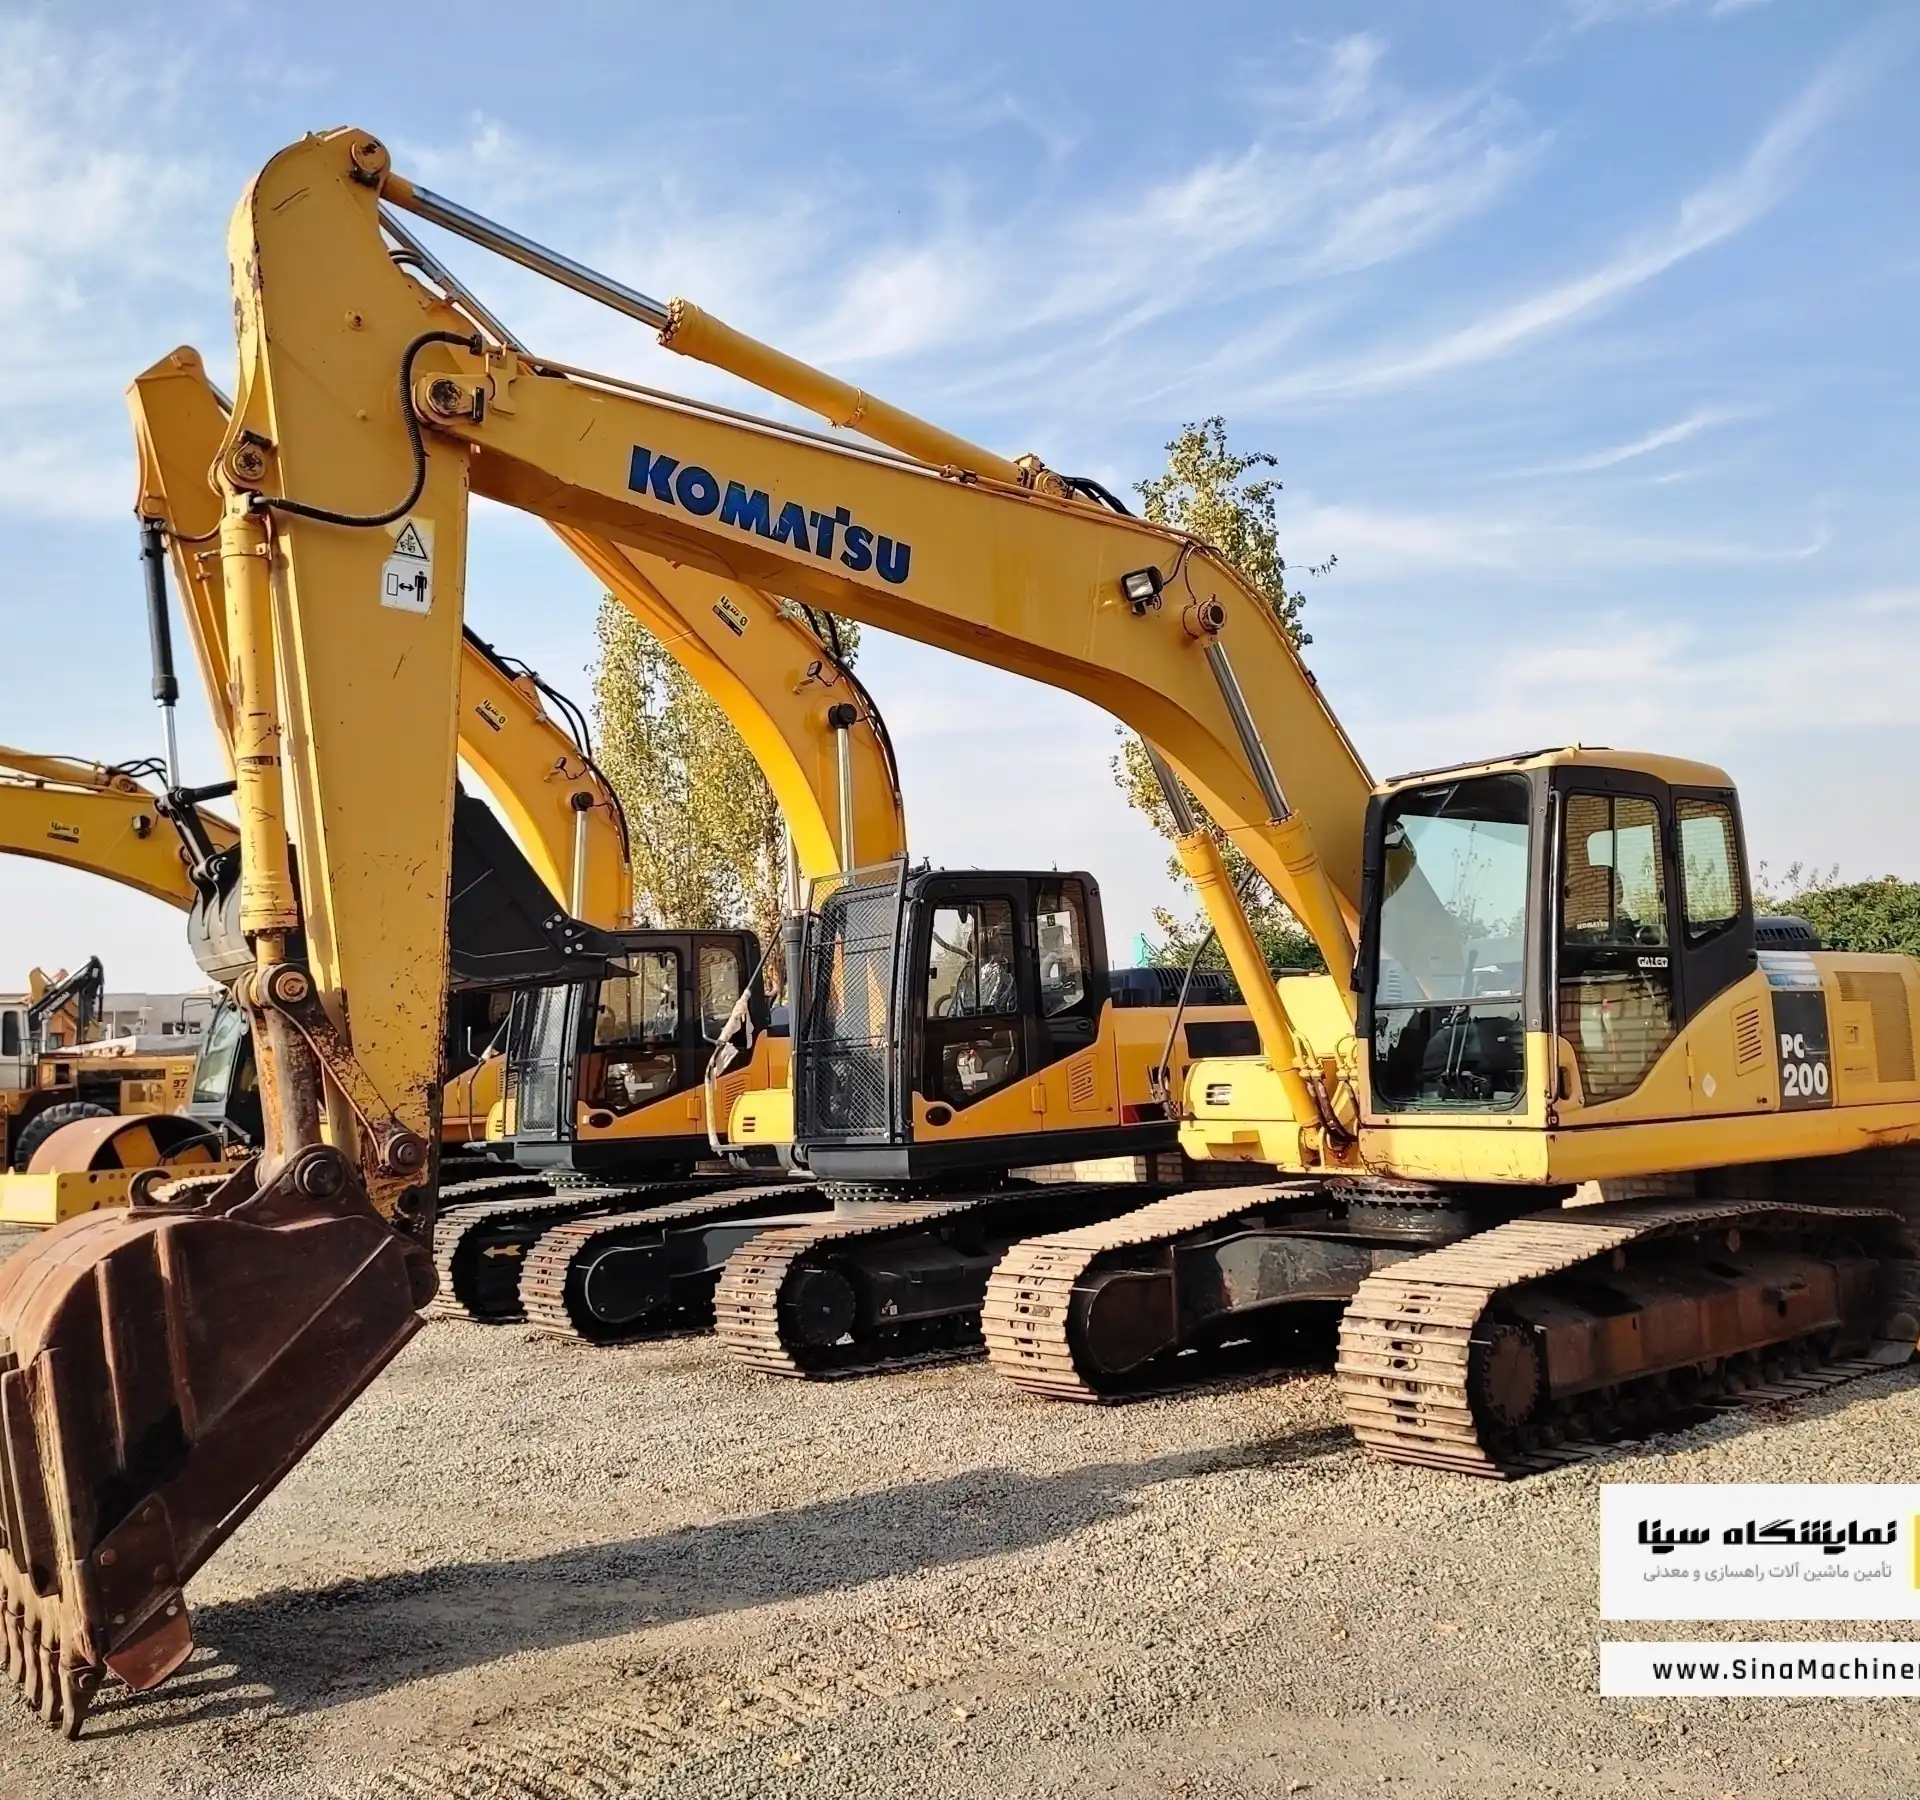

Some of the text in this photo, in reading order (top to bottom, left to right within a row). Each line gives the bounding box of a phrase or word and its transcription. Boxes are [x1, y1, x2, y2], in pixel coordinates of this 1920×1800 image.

[628, 445, 911, 584] KOMATSU
[1780, 1033, 1805, 1059] PC
[1783, 1062, 1829, 1097] 200
